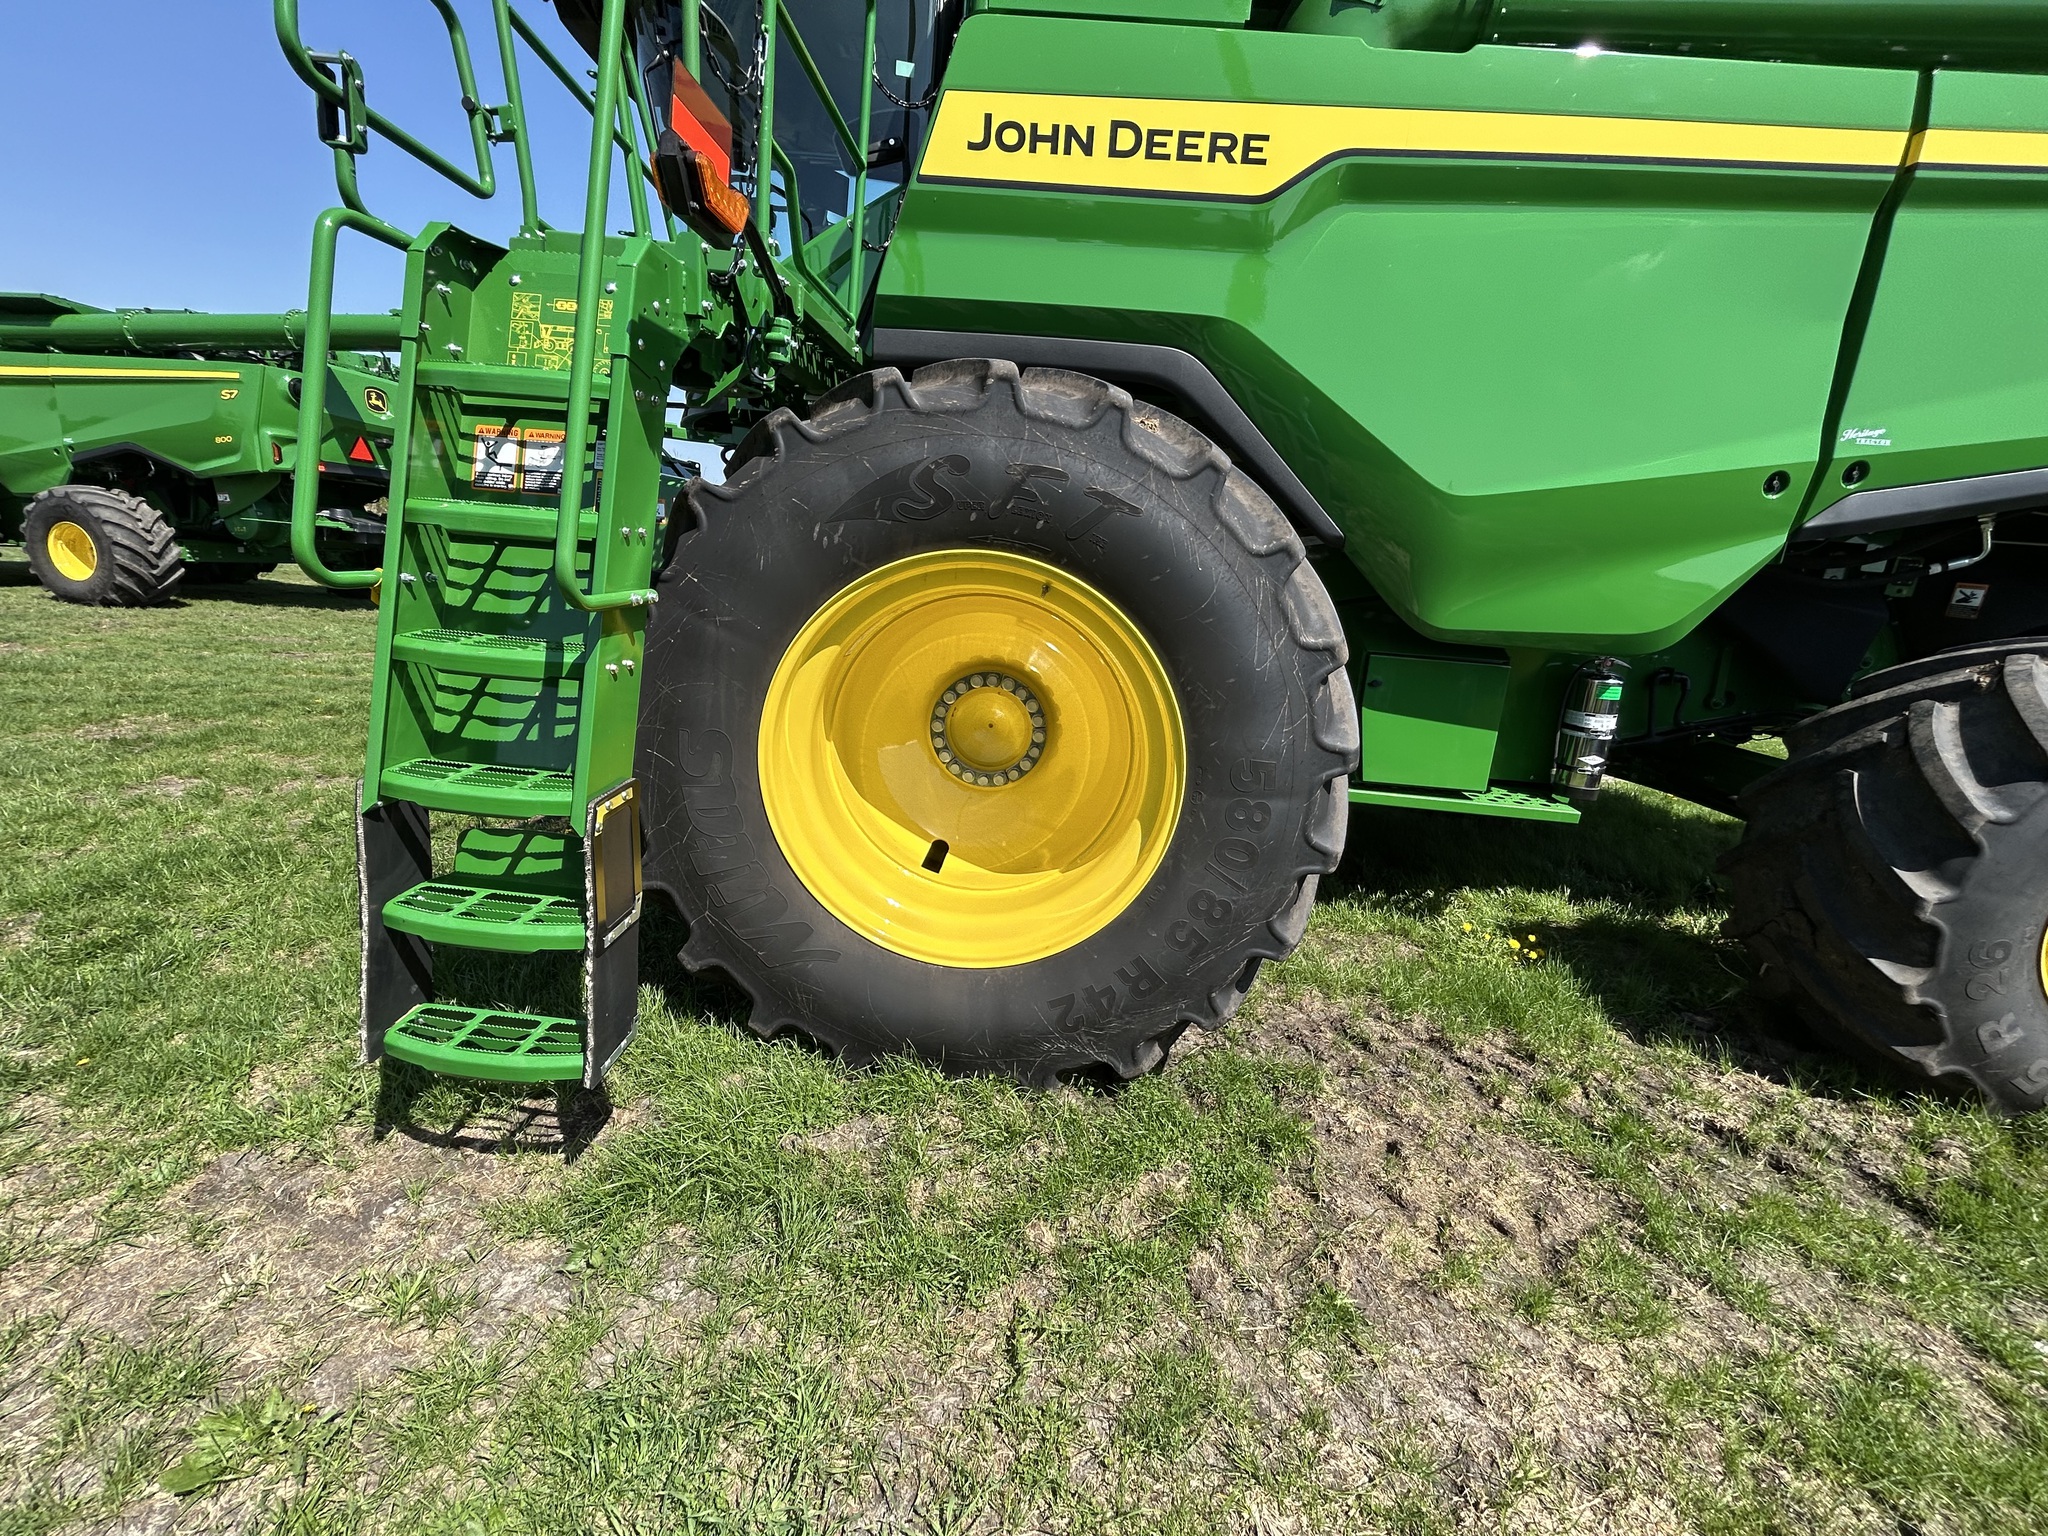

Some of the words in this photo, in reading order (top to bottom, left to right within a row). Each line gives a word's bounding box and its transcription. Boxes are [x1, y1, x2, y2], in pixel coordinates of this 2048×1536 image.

[966, 112, 1095, 157] JOHN
[1108, 119, 1270, 165] DEERE
[220, 389, 239, 400] S7
[485, 427, 519, 437] WARNING
[215, 435, 233, 444] 800
[1164, 757, 1277, 953] 580/85
